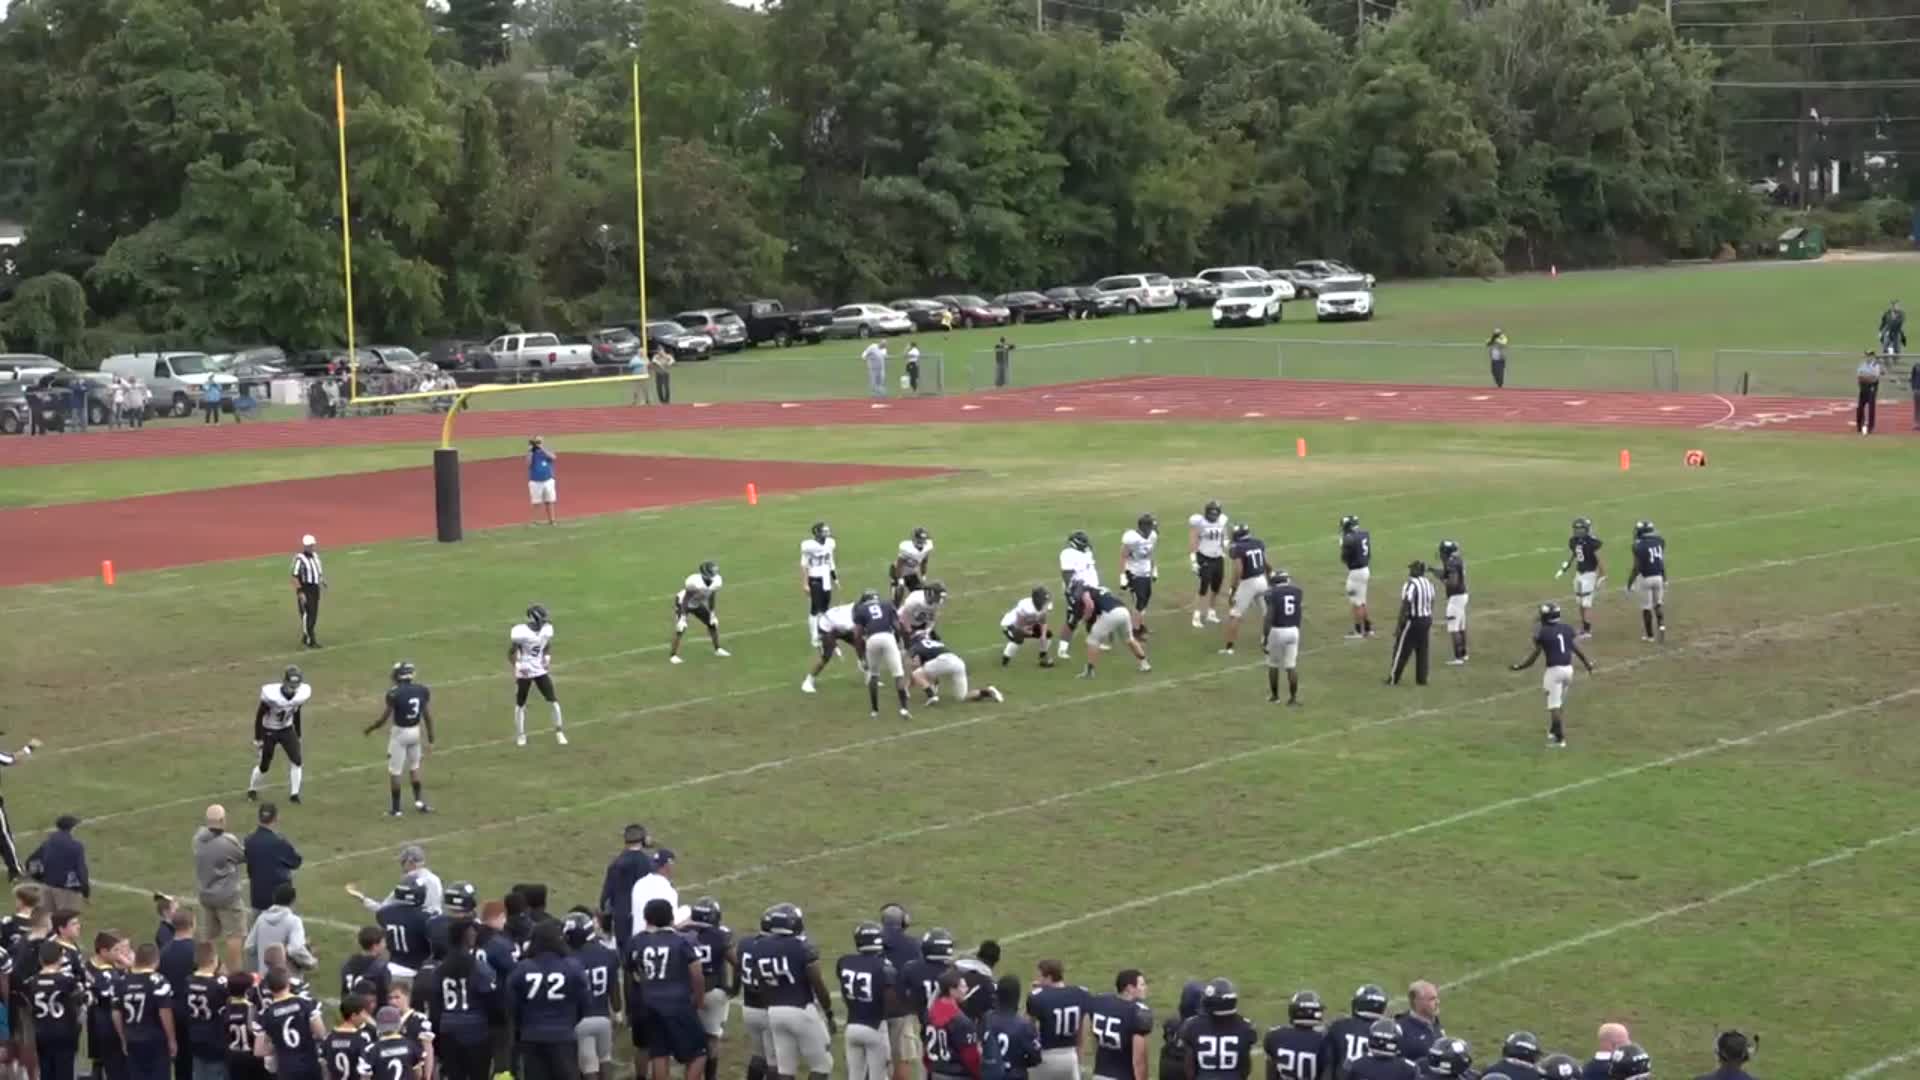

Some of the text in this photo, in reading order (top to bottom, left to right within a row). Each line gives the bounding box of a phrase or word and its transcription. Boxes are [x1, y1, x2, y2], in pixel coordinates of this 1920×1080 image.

[1246, 548, 1264, 569] 77
[1648, 545, 1663, 563] 14
[868, 604, 883, 620] 9
[1284, 595, 1296, 616] 6
[1557, 633, 1566, 653] 1
[407, 698, 420, 719] 3
[386, 924, 409, 953] 71
[643, 946, 670, 980] 67
[758, 955, 795, 986] 54
[442, 977, 469, 1010] 61
[525, 973, 566, 999] 72
[841, 969, 873, 1002] 33
[34, 990, 65, 1018] 56
[124, 993, 146, 1023] 57
[187, 993, 213, 1020] 53
[282, 1016, 300, 1048] 6
[1053, 1006, 1081, 1036] 10
[1093, 1013, 1121, 1049] 55
[229, 1024, 251, 1051] 21
[926, 1025, 951, 1061] 20
[1198, 1035, 1239, 1069] 26
[335, 1053, 351, 1080] 9
[1277, 1048, 1317, 1080] 20
